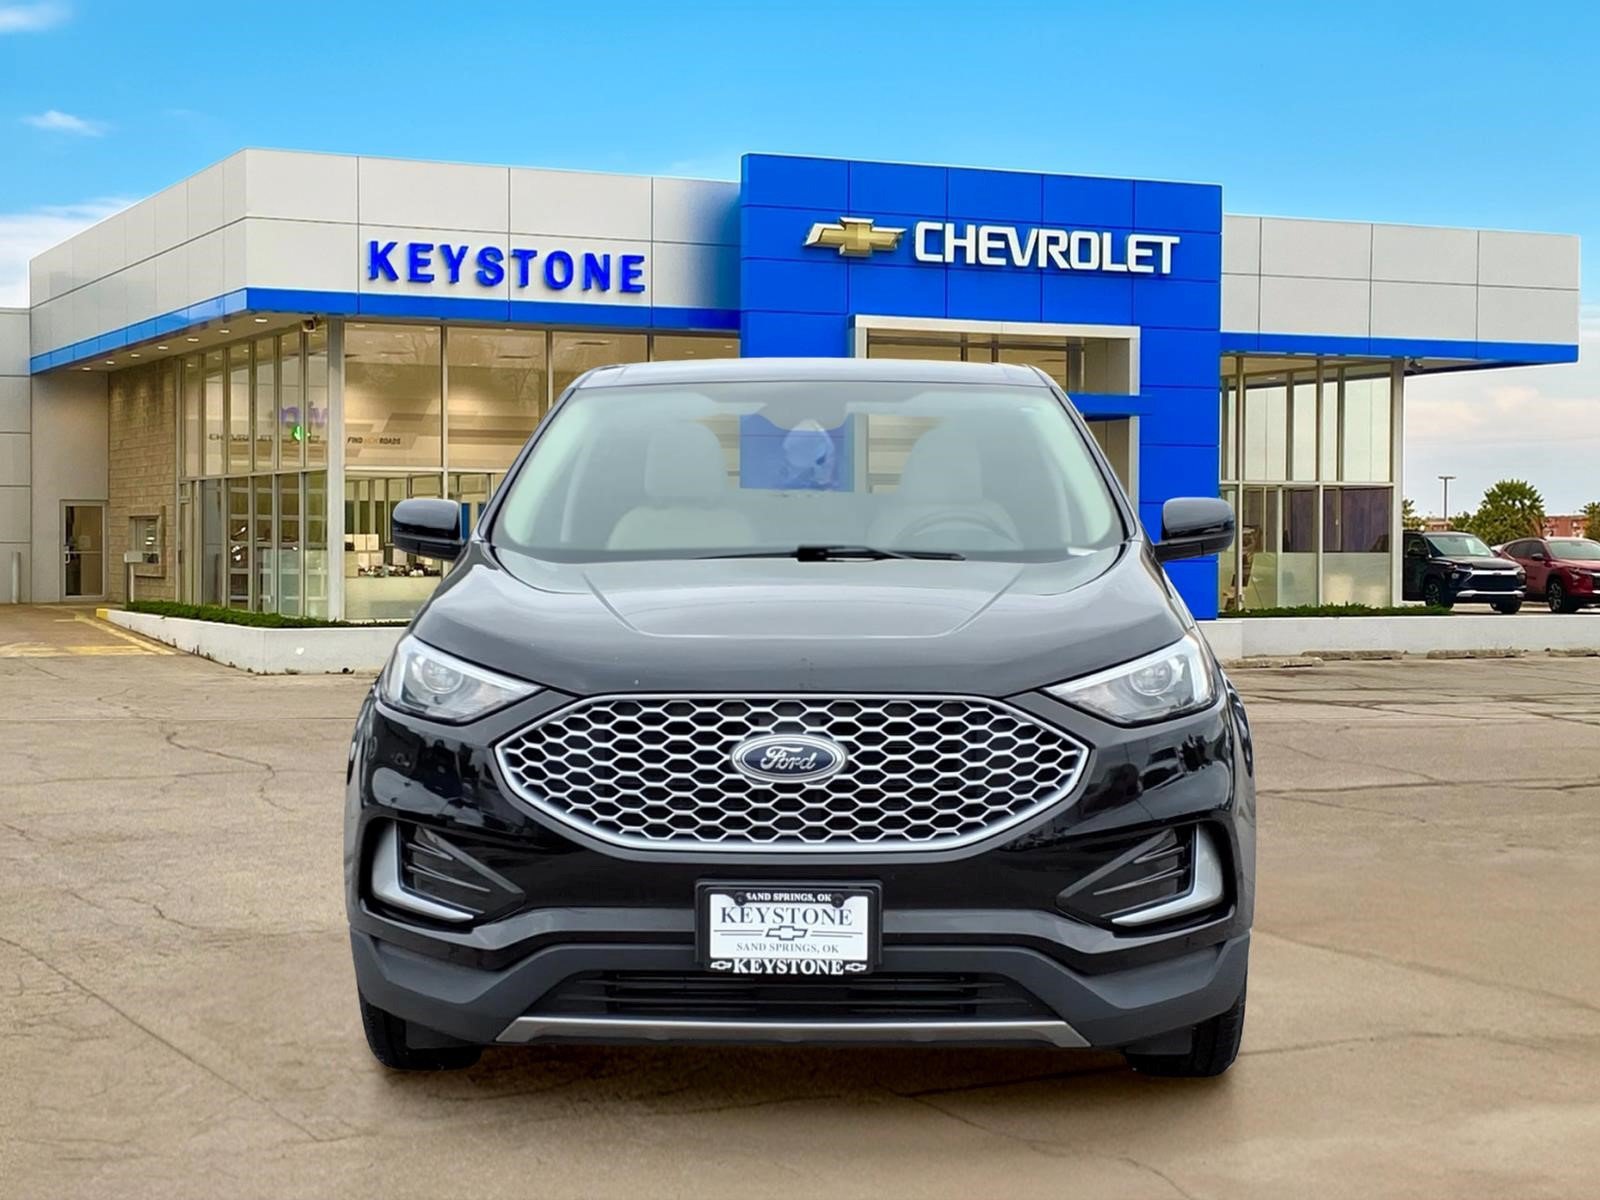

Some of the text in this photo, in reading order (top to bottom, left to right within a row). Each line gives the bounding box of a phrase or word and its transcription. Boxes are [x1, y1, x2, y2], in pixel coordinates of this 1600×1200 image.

[914, 221, 1180, 275] CHEVROLET
[368, 240, 646, 293] KEYSTONE
[760, 745, 818, 770] Ford
[746, 892, 832, 903] SAND SPRINGS, OK
[721, 907, 853, 927] KEYSTONE
[736, 943, 840, 954] SAND SPRINGS, OK
[732, 958, 844, 975] KEYSTONE
